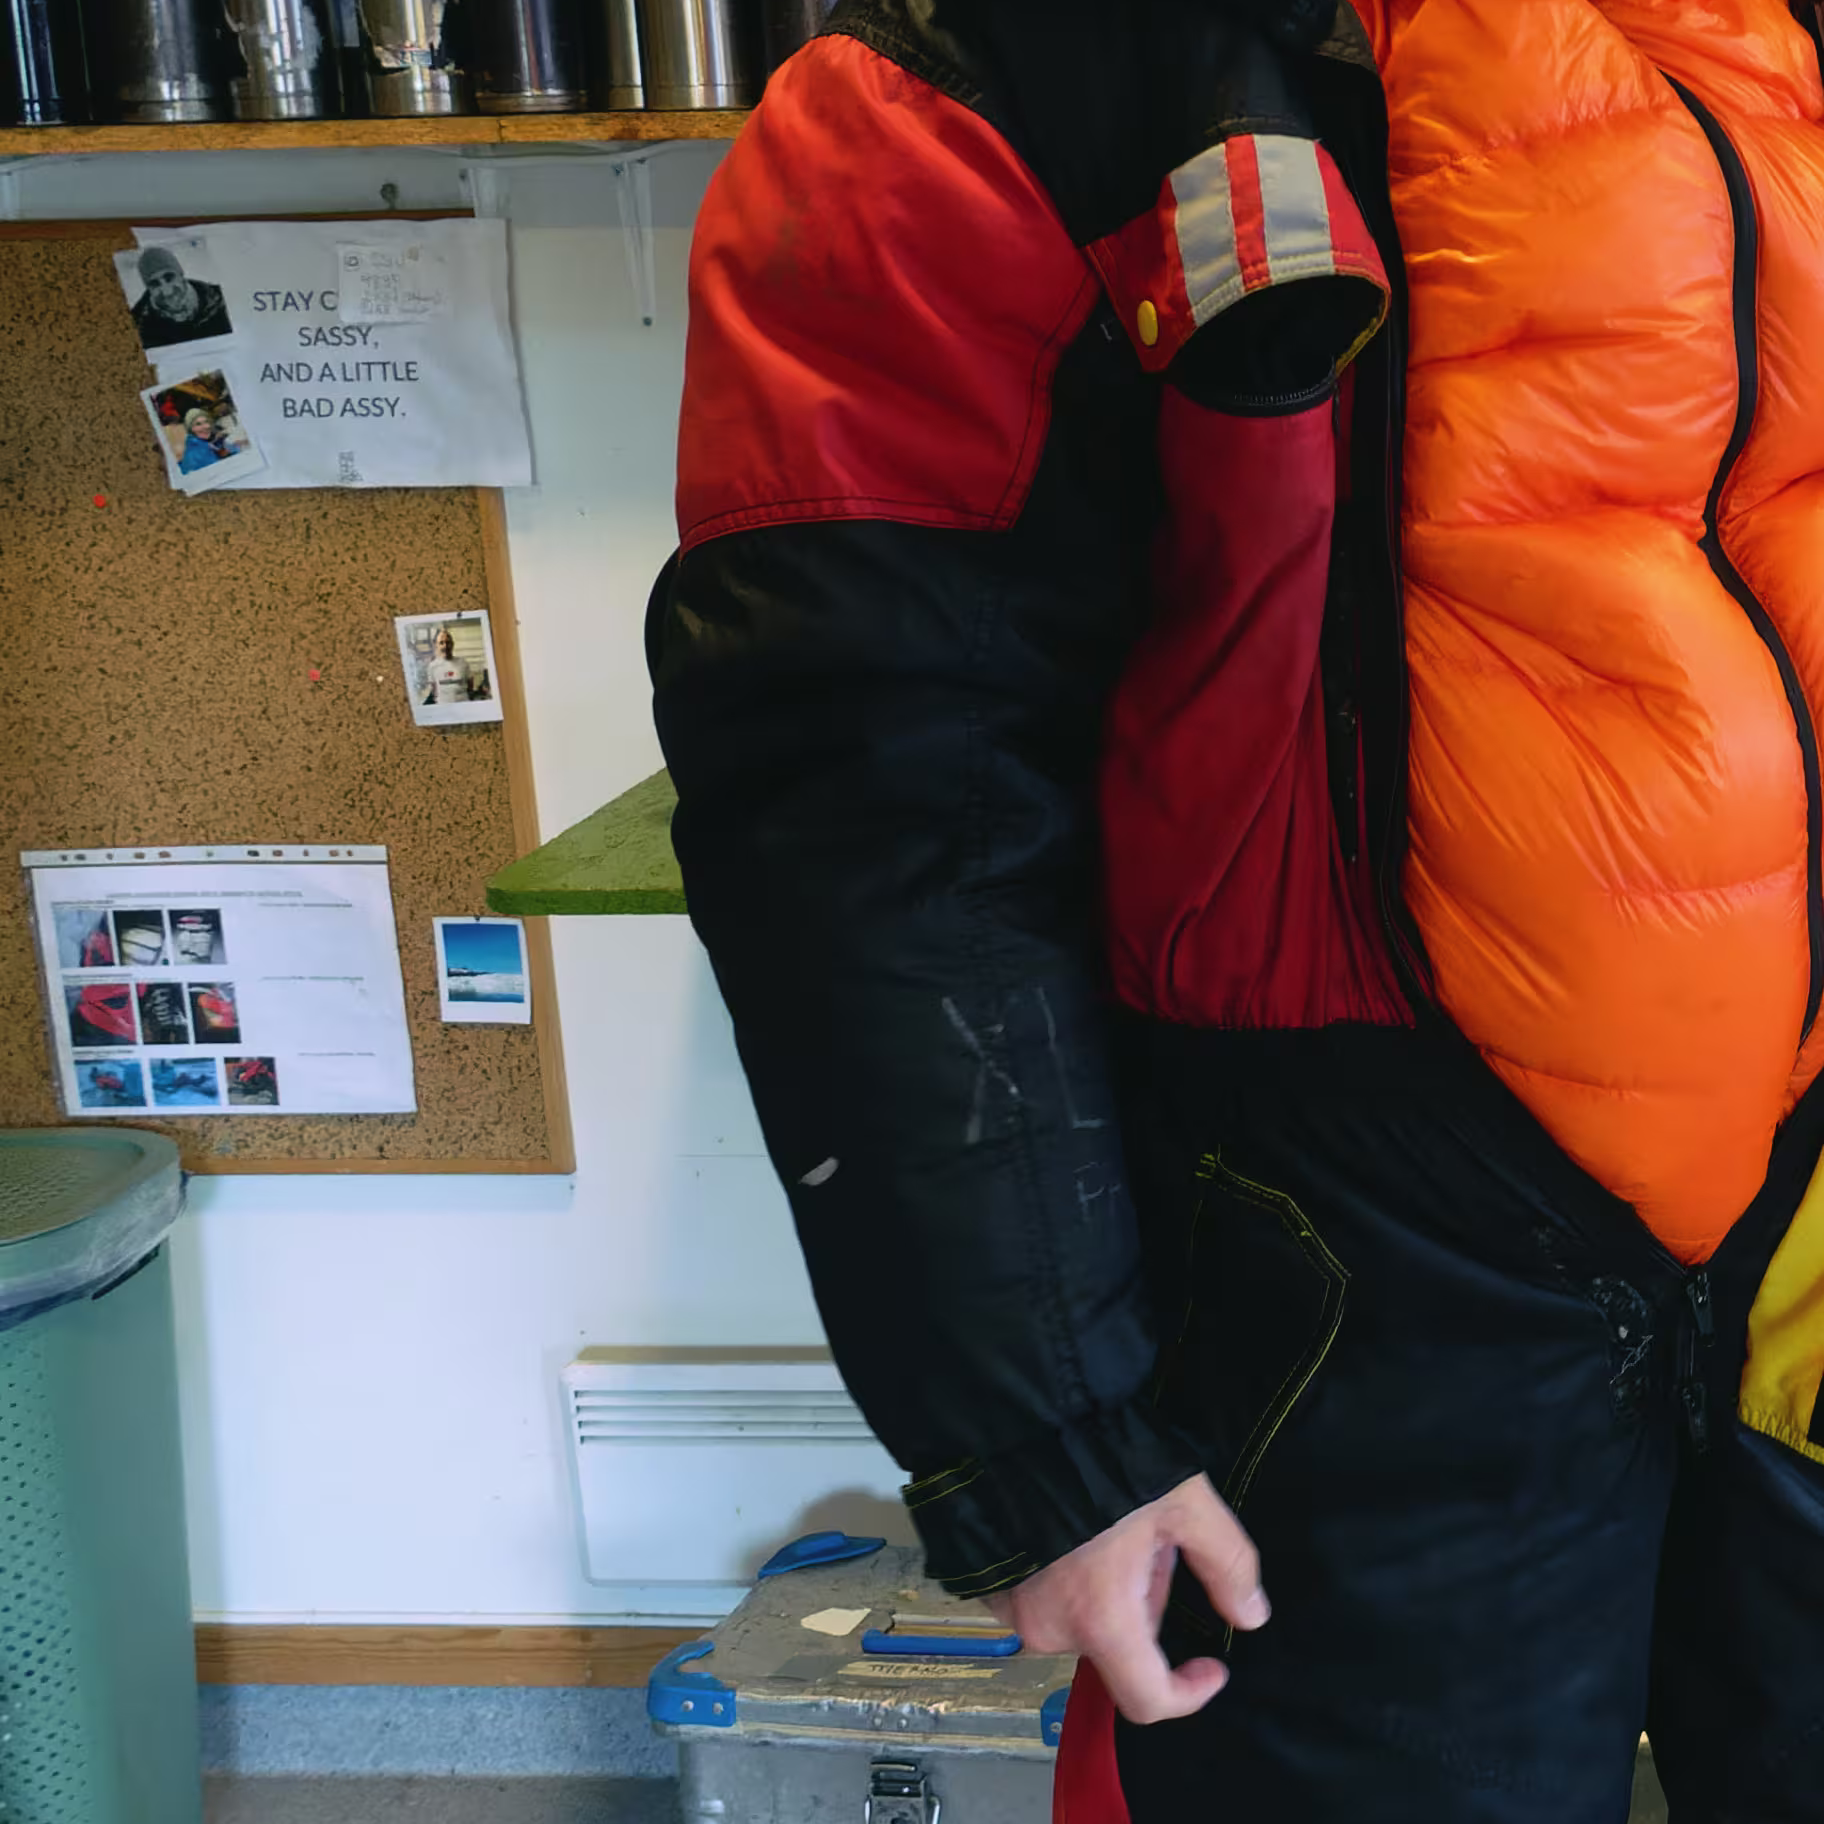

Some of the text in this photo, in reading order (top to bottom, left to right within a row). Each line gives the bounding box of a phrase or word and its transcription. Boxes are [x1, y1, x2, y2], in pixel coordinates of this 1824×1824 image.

[253, 291, 314, 312] STAY
[260, 361, 419, 383] AND A LITTLE
[282, 397, 407, 418] BAD ASSY.
